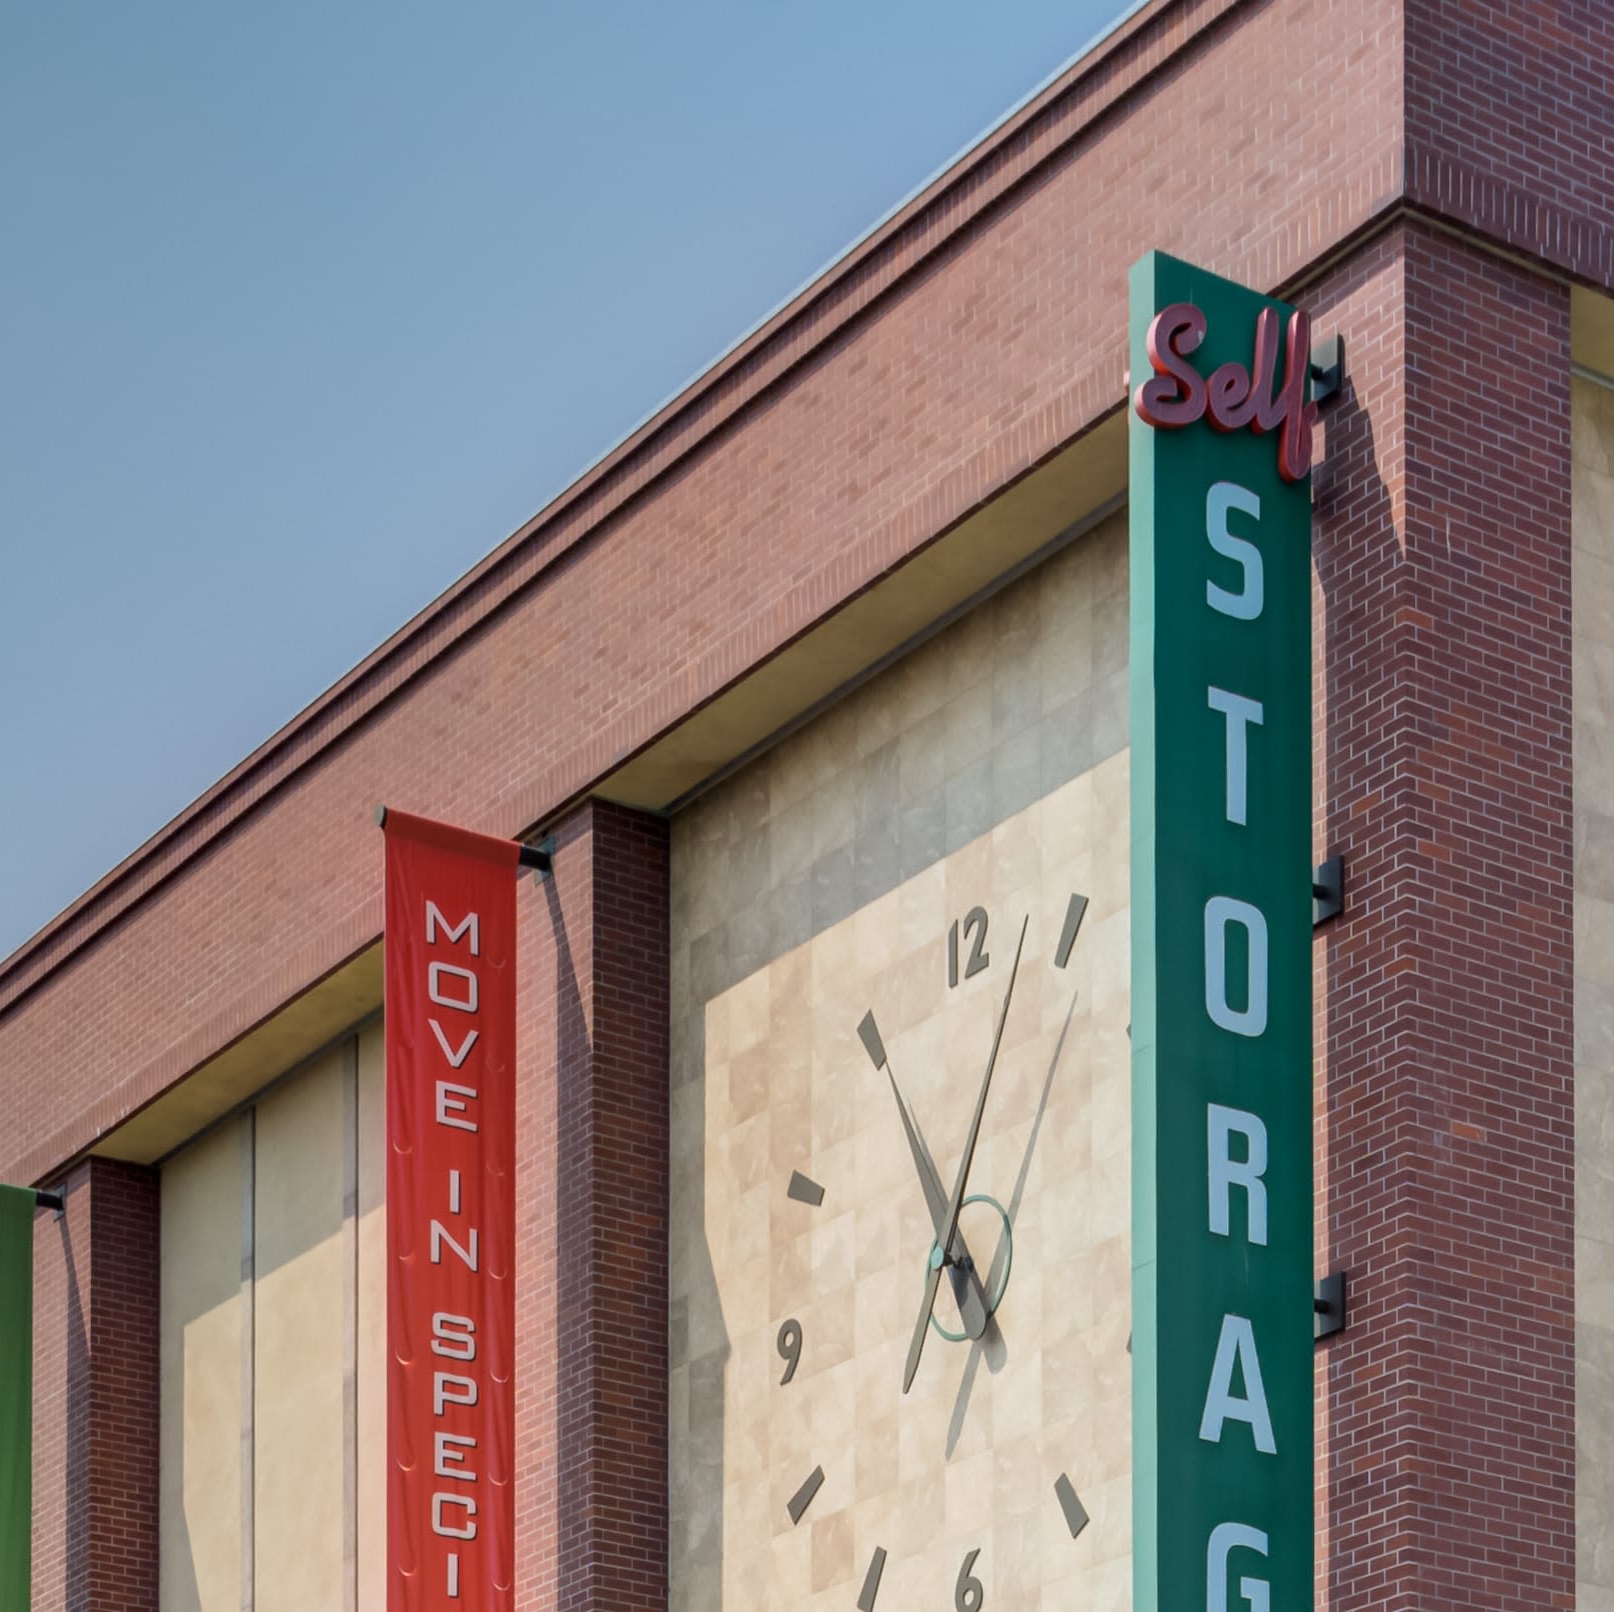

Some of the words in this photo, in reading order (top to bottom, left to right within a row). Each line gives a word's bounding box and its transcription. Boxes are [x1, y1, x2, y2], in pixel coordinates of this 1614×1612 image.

[1135, 302, 1317, 482] Self
[947, 906, 990, 988] 12
[425, 900, 480, 1133] MOVE
[429, 1169, 479, 1272] IN
[776, 1318, 803, 1386] 9
